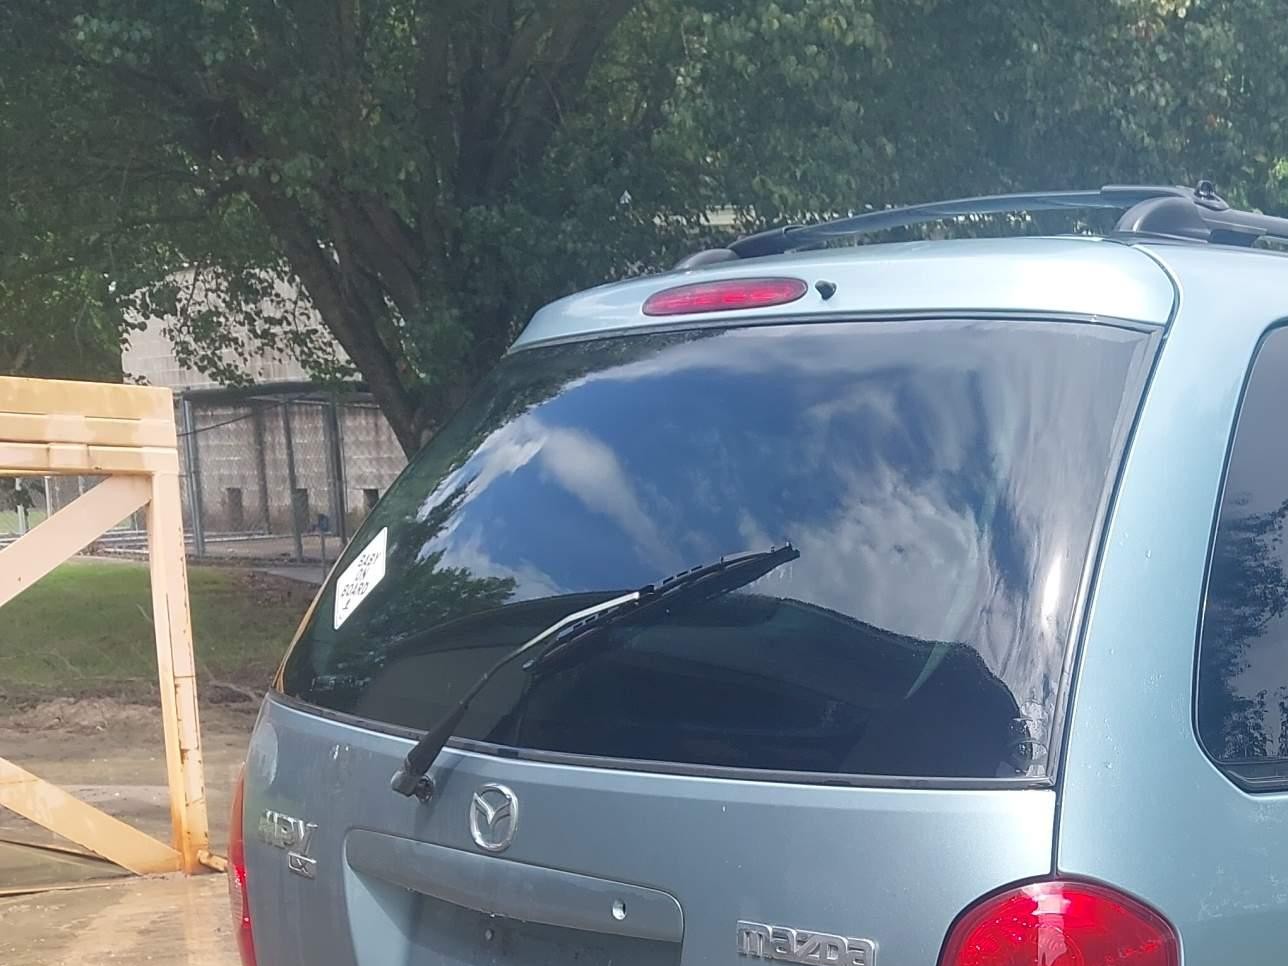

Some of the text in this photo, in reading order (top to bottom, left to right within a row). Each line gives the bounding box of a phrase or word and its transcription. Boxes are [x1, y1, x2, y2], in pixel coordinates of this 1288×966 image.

[358, 552, 380, 567] BABY
[341, 582, 369, 597] BOARD
[258, 808, 319, 857] MPV
